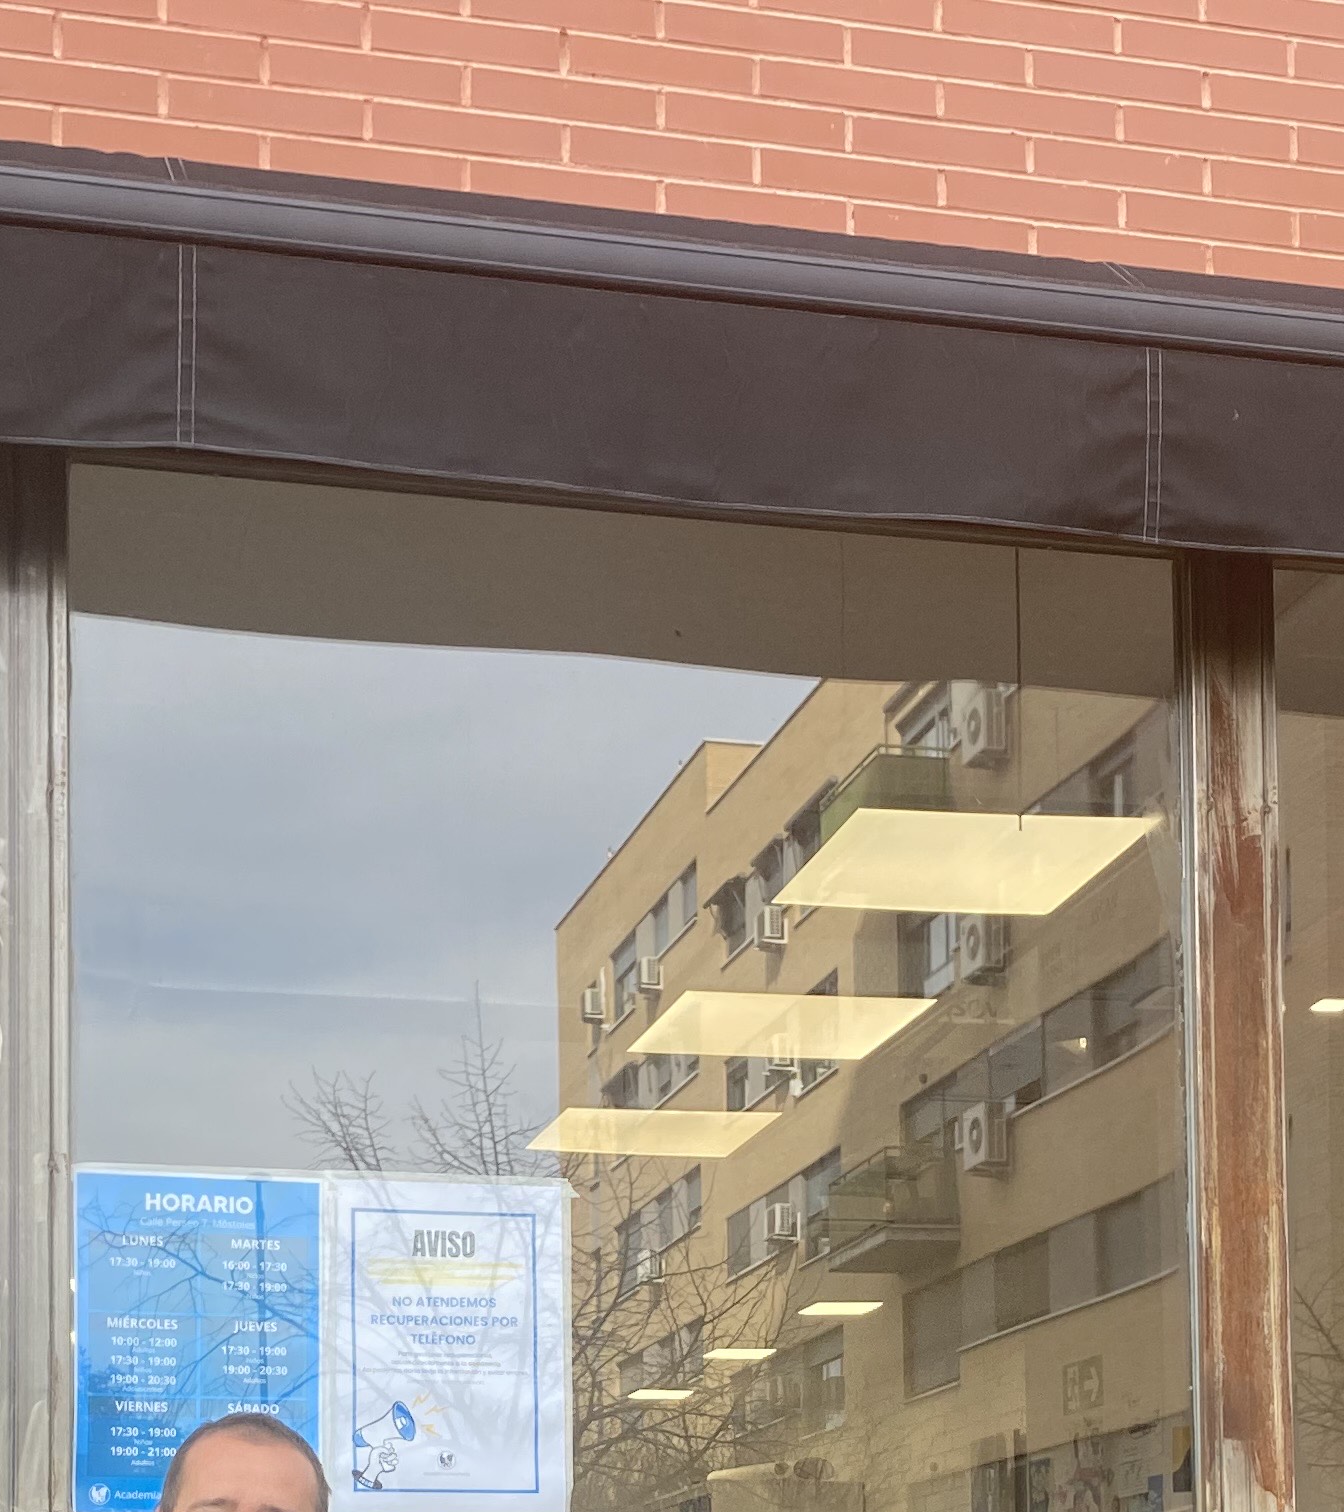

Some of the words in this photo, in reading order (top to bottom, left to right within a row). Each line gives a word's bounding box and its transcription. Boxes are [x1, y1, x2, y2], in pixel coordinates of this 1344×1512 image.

[144, 1192, 254, 1215] HORARIO
[122, 1234, 164, 1247] LUNES
[230, 1238, 281, 1251] MARTES
[411, 1229, 476, 1259] AVISO
[109, 1257, 138, 1268] 17:30
[148, 1258, 176, 1269] 19:00
[222, 1260, 251, 1271] 16:00
[259, 1262, 288, 1273] 17:30
[259, 1282, 288, 1293] 19:00
[392, 1296, 413, 1308] NO
[415, 1296, 497, 1309] ATENDEMOS
[106, 1315, 179, 1330] MIÉRCOLES
[233, 1320, 278, 1333] JUEVES
[370, 1313, 488, 1327] RECUPERACIONES
[492, 1315, 519, 1328] POR
[111, 1336, 140, 1347] 10:00
[149, 1337, 177, 1348] 12:00
[410, 1331, 476, 1346] TELÉFONO
[221, 1345, 250, 1356] 17:30
[258, 1347, 287, 1357] 19:00
[110, 1355, 139, 1366] 17:30
[148, 1357, 177, 1367] 19:00
[222, 1365, 251, 1375] 19:00
[259, 1366, 288, 1376] 20:30
[110, 1374, 139, 1385] 19:00
[147, 1375, 177, 1386] 20:30
[115, 1401, 169, 1413] VIERNES
[227, 1400, 280, 1414] SÁBADO
[110, 1427, 139, 1438] 17:30
[148, 1428, 177, 1438] 19:00
[110, 1446, 139, 1457] 19:00
[147, 1447, 177, 1457] 21:00
[113, 1489, 162, 1501] Academia
